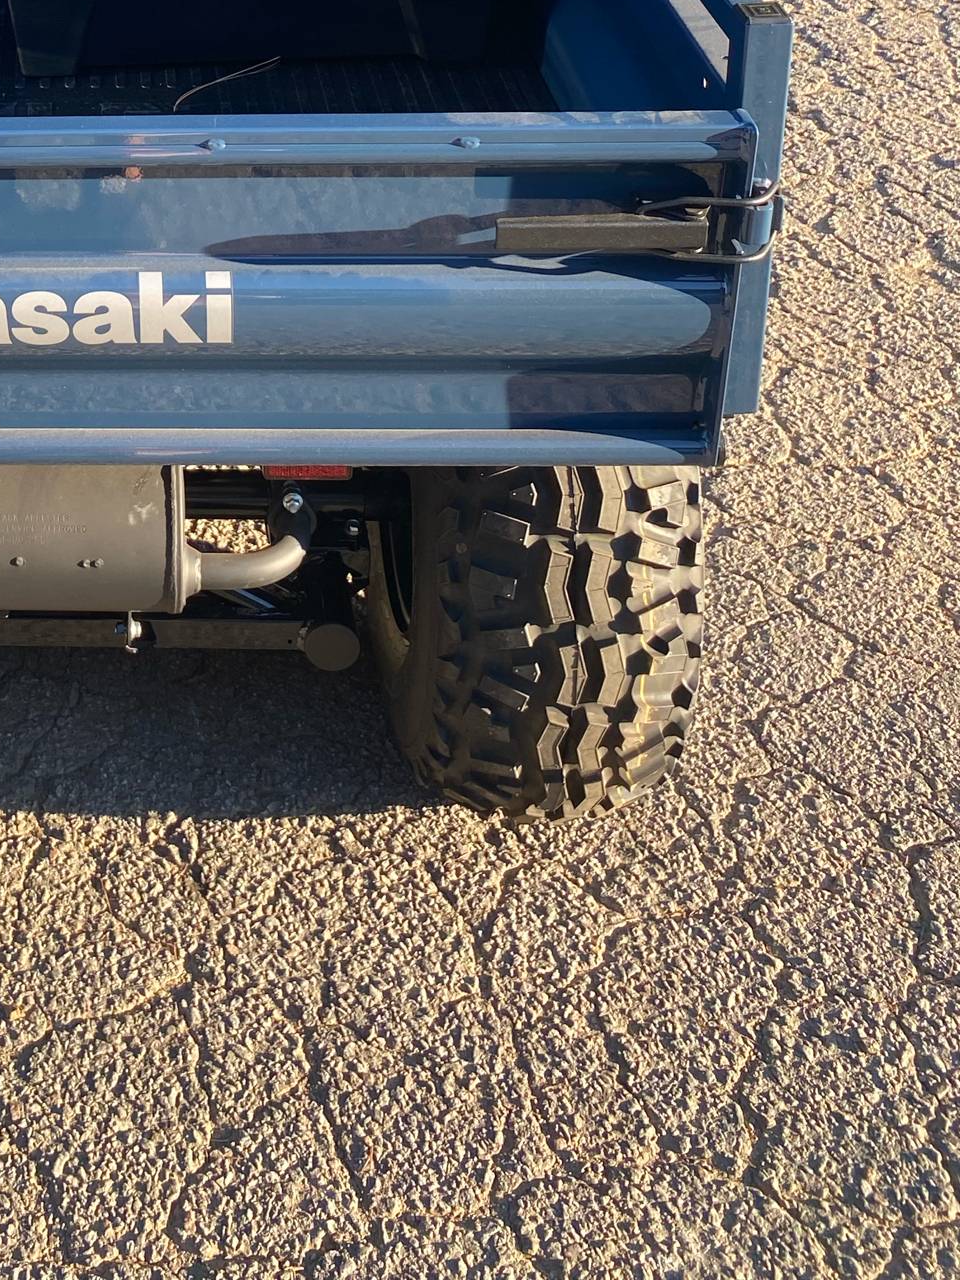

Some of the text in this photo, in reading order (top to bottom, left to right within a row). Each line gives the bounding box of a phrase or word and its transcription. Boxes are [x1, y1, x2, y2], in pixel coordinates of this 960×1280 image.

[25, 514, 69, 522] ARRESTER
[1, 524, 35, 533] SERVICE
[43, 525, 87, 533] APPROVED
